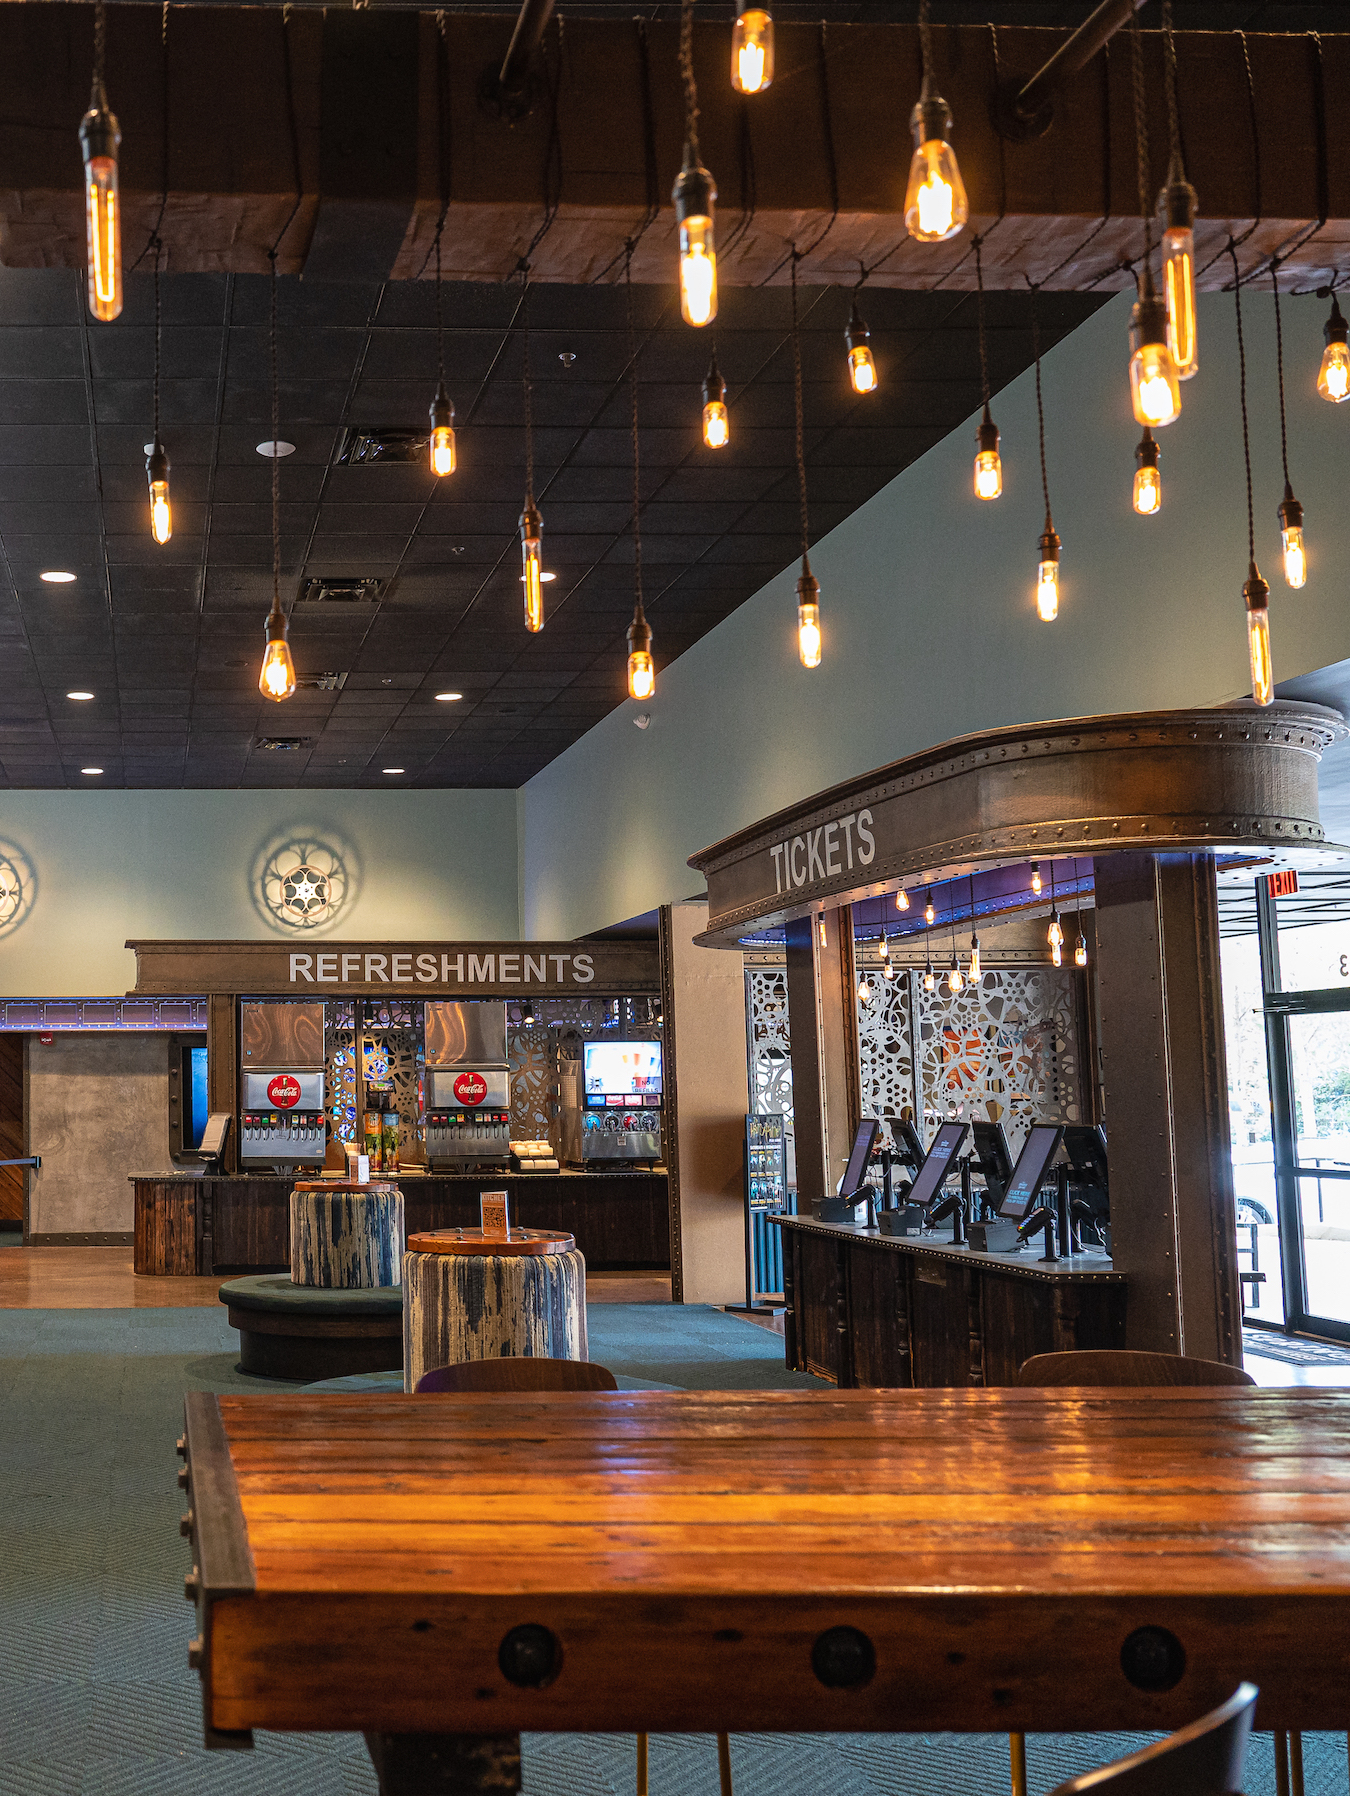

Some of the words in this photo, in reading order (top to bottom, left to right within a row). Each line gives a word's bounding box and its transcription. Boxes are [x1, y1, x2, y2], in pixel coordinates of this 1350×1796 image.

[770, 808, 876, 894] TICKETS
[1272, 870, 1295, 897] EXIT
[289, 953, 595, 983] REFRESHMENTS
[272, 1087, 299, 1097] Coca-Cola
[458, 1084, 484, 1094] Coca-Cola
